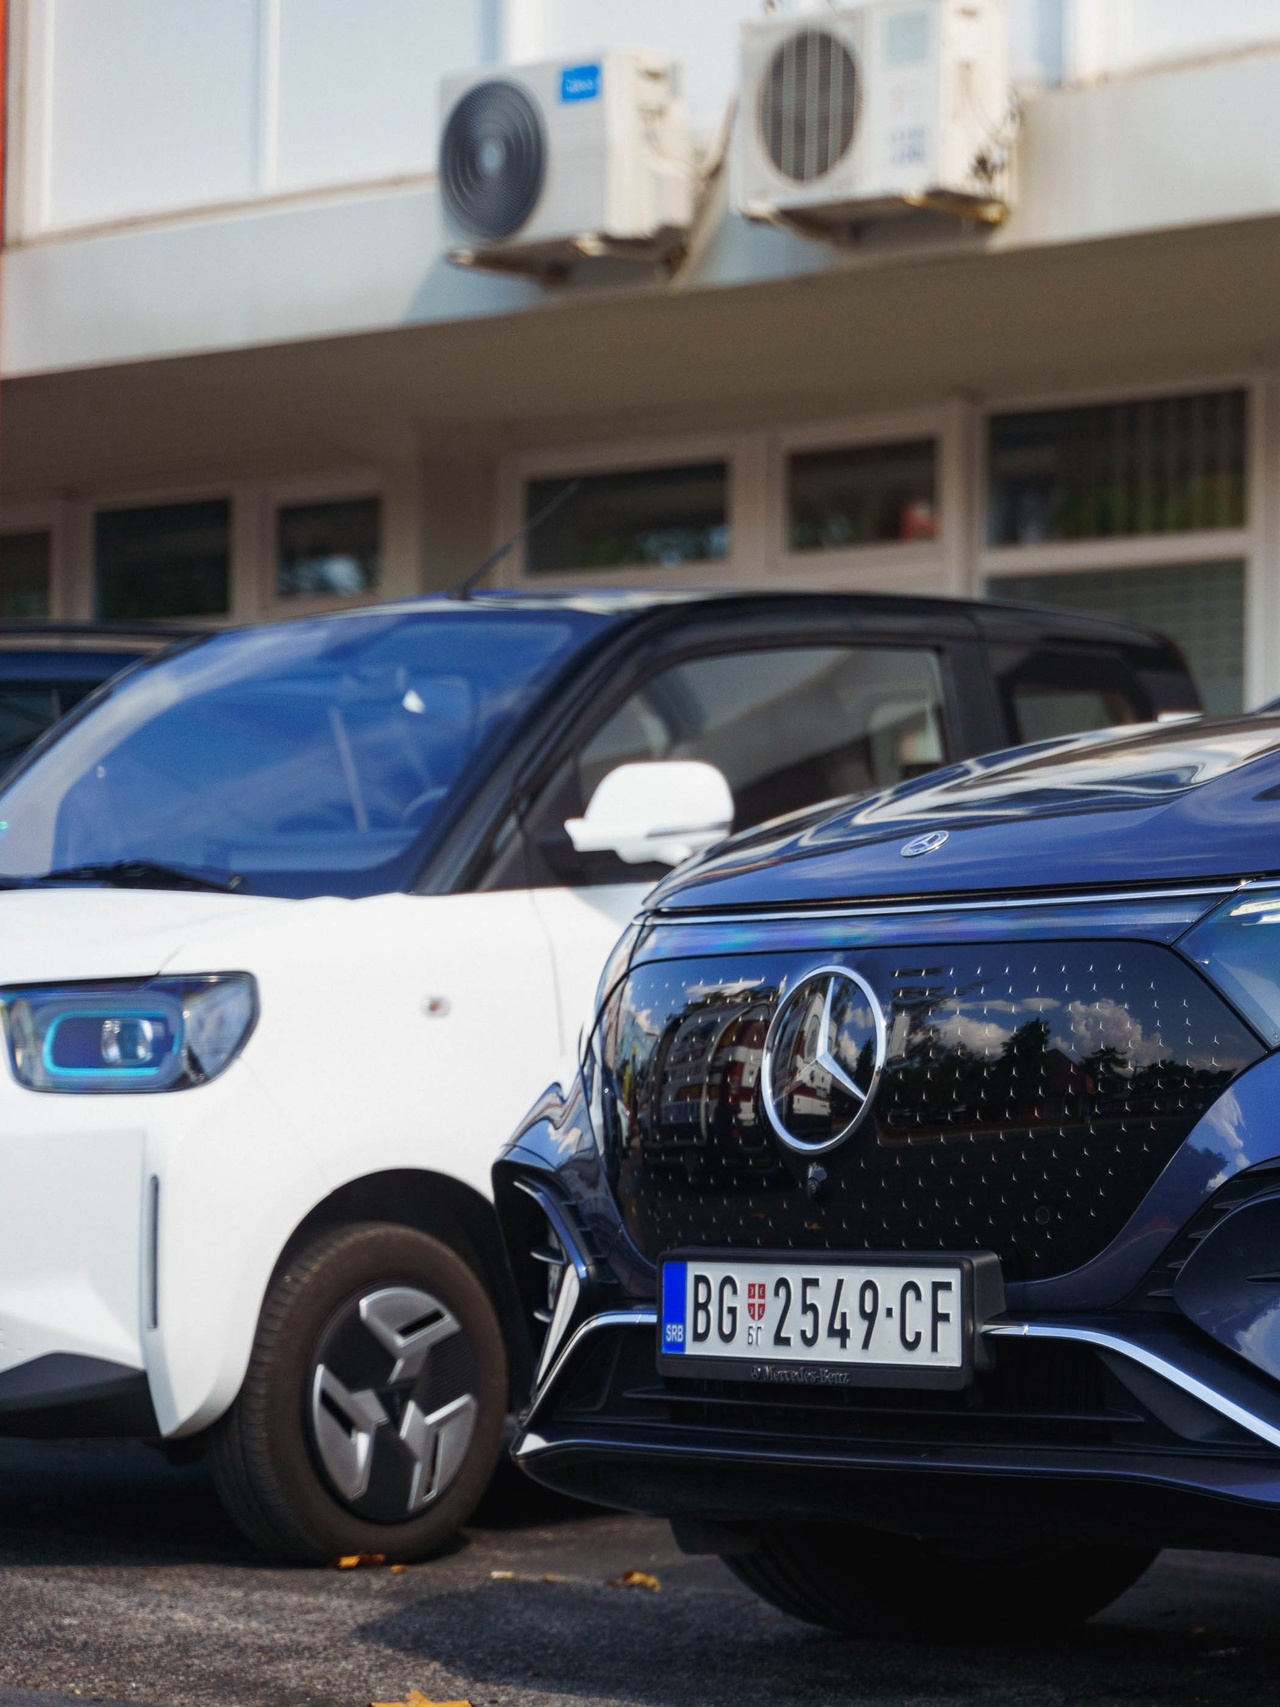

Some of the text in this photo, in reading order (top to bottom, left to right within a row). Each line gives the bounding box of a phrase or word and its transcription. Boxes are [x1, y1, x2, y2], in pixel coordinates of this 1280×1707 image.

[692, 1274, 739, 1344] BG
[665, 1323, 685, 1343] SRB
[764, 1365, 850, 1384] Mercedes-Benz
